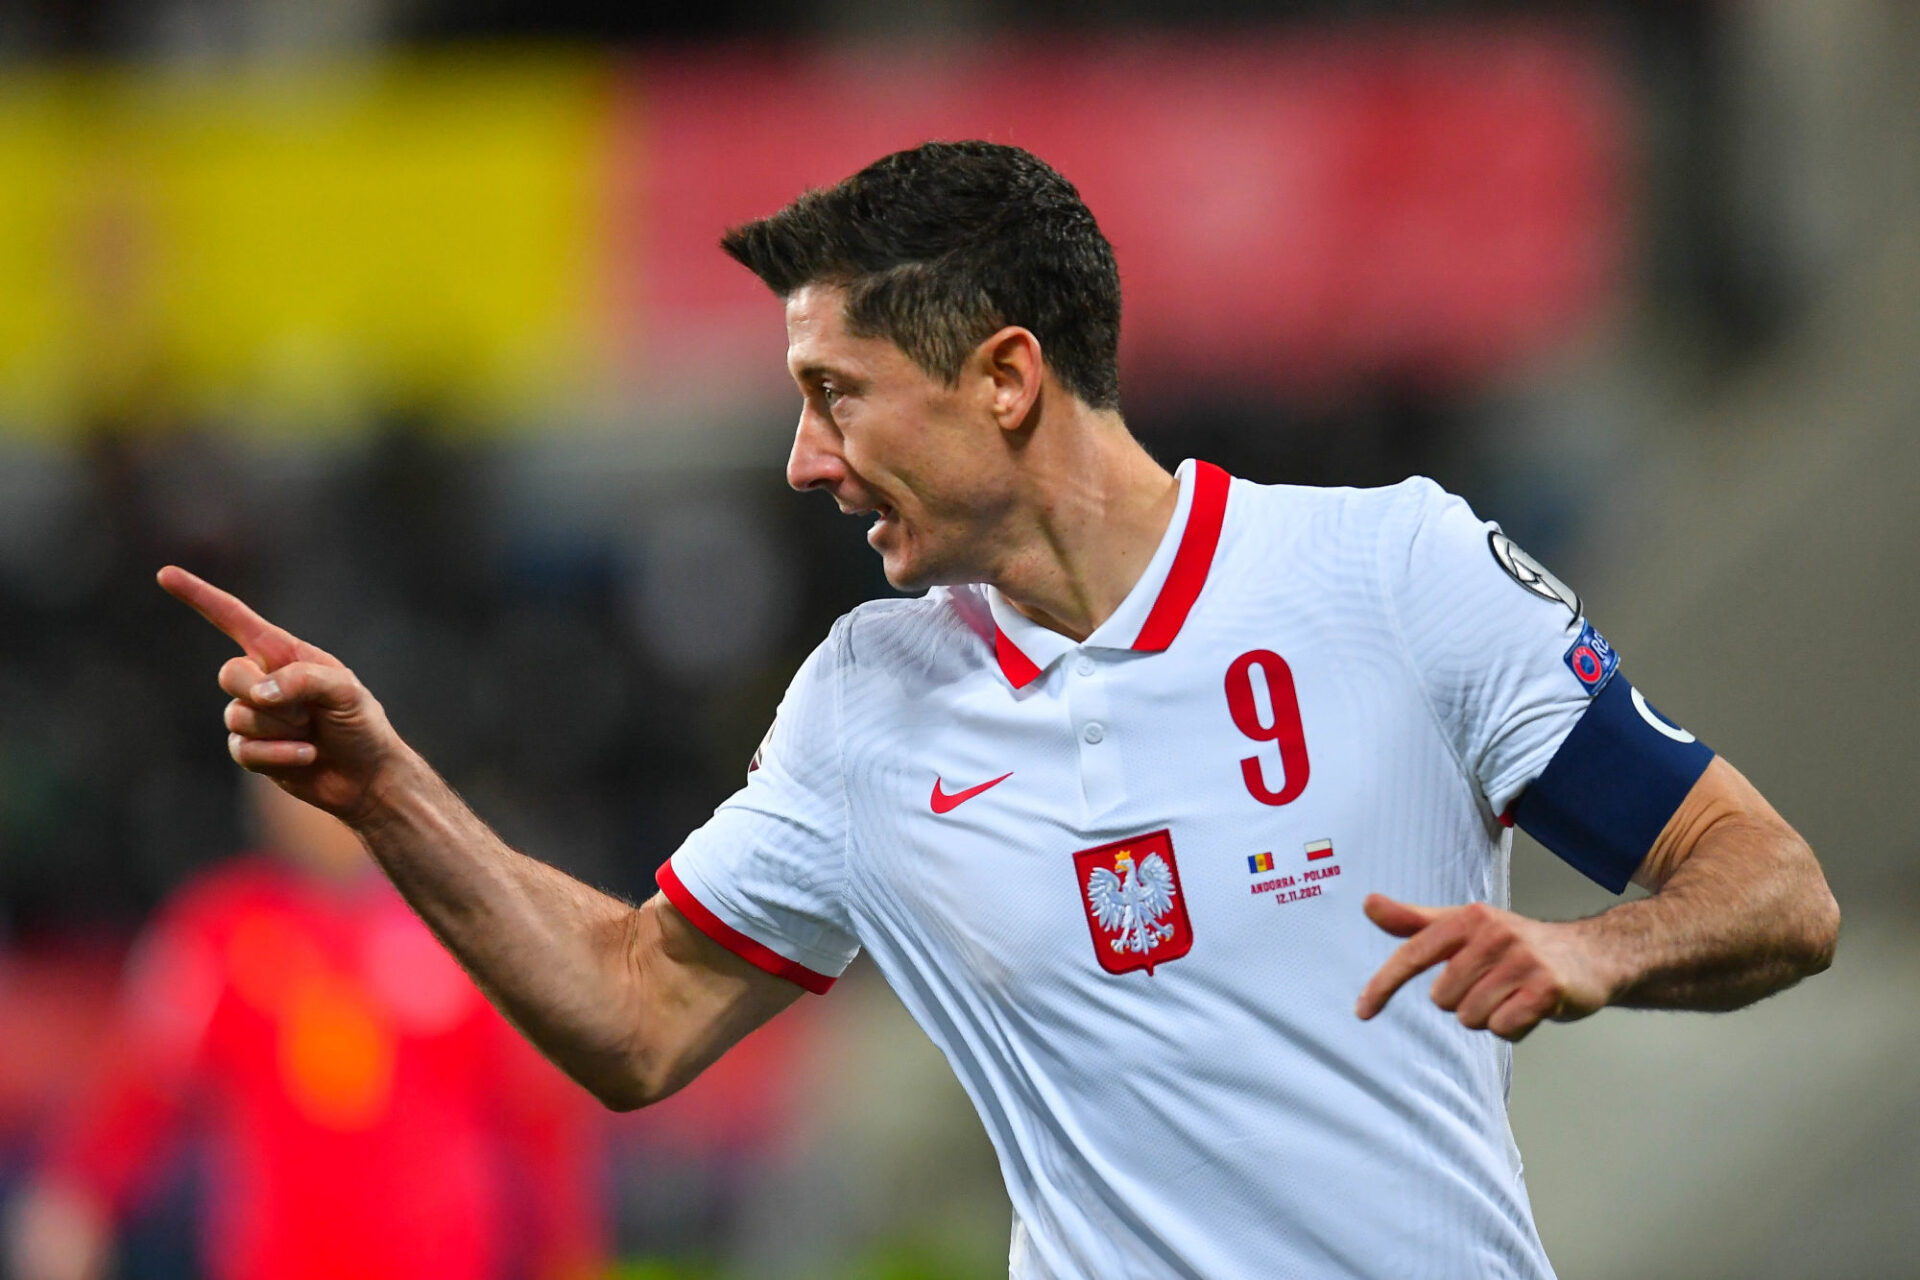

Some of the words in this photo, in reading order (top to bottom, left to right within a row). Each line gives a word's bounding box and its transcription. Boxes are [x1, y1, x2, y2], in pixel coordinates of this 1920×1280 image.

[1224, 648, 1310, 806] 9
[1251, 876, 1295, 894] ANDORRA
[1304, 865, 1340, 882] POLAND
[1276, 885, 1321, 904] 12.11.2021
